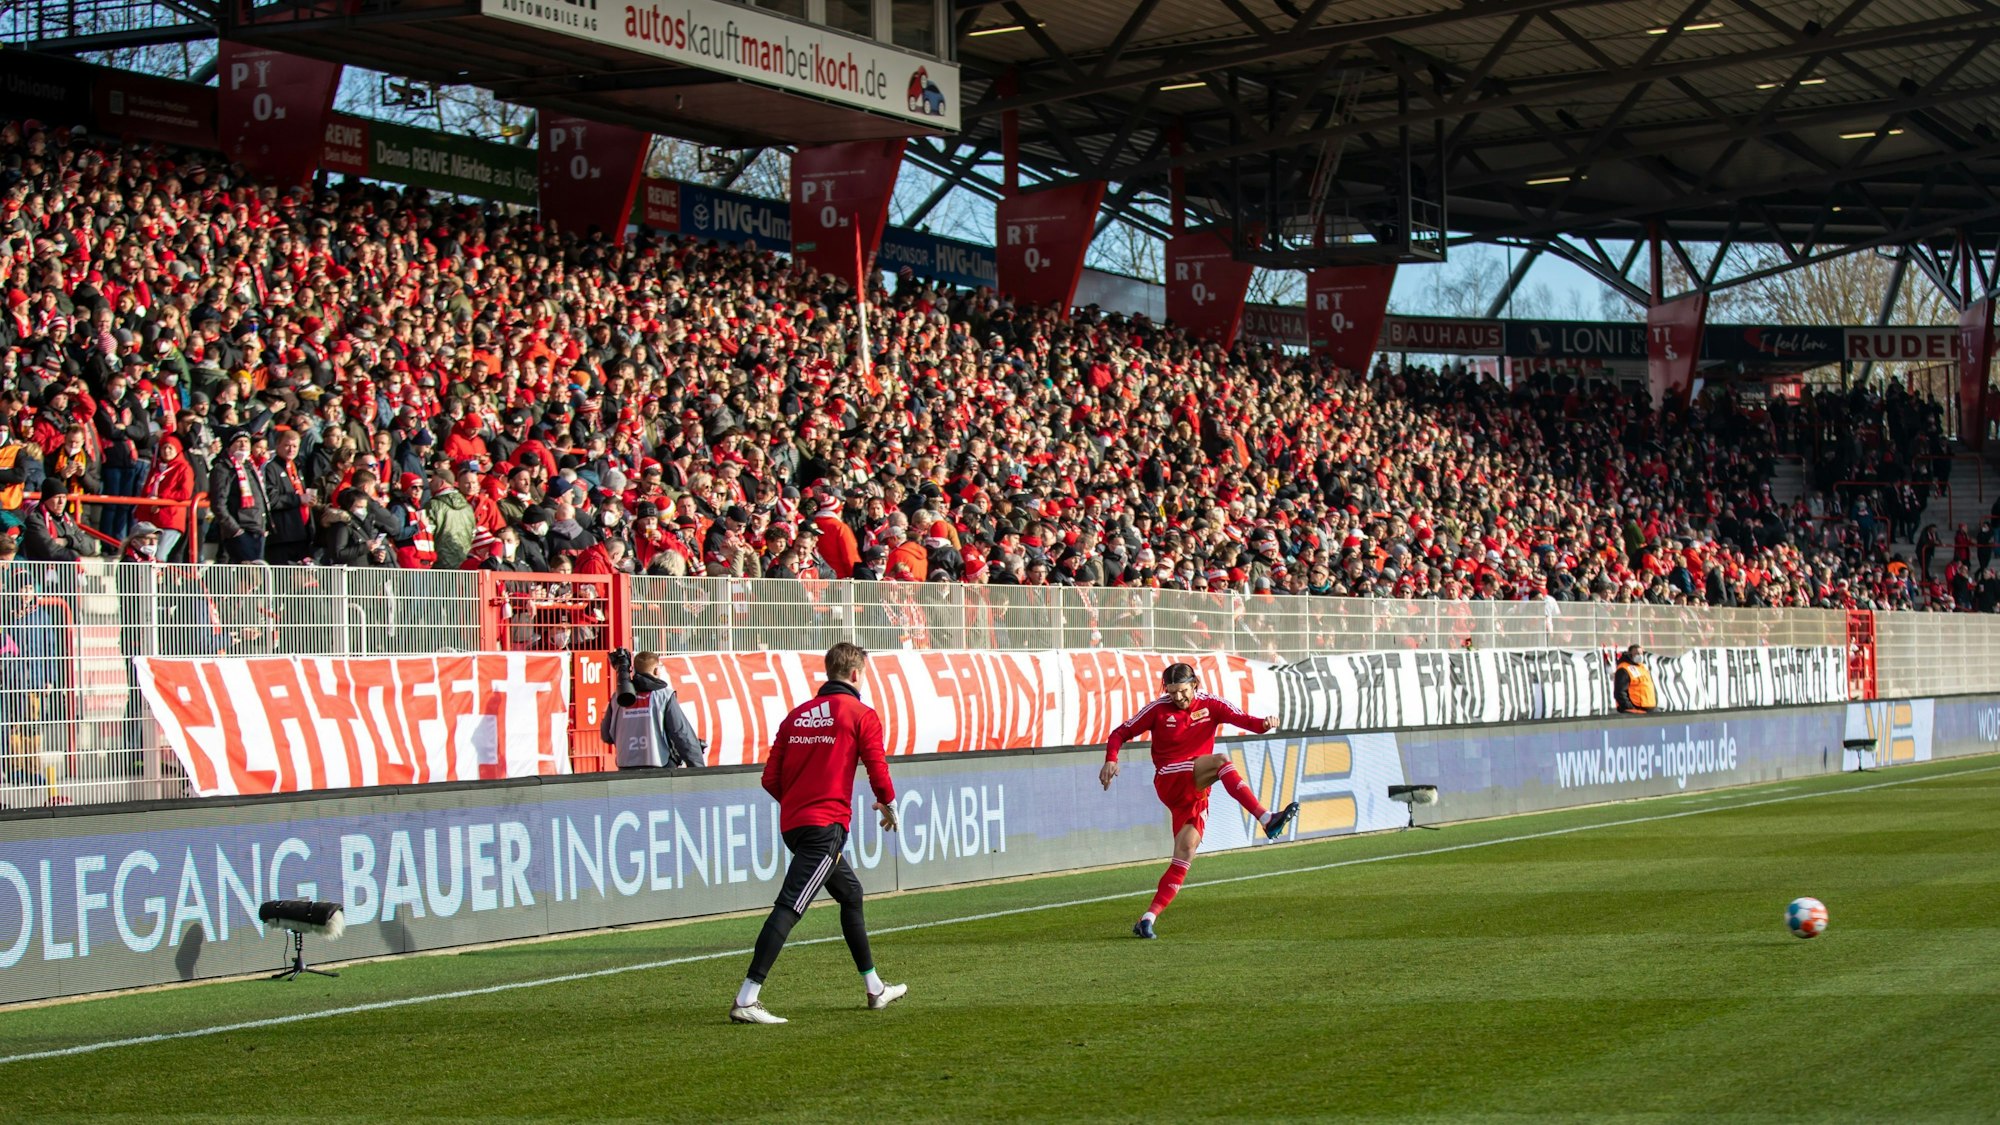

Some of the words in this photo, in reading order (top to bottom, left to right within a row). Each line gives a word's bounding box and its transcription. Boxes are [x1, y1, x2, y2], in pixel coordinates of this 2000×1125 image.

[502, 0, 578, 27] AUTOMOBILE
[584, 16, 598, 31] AG
[625, 4, 887, 100] autoskauftmanbeikoch.de
[231, 63, 249, 91] P
[252, 93, 273, 121] O
[325, 123, 363, 149] REWE
[550, 127, 566, 153] P
[342, 151, 363, 167] Markt
[376, 140, 411, 169] Deine
[412, 147, 449, 176] REWE
[450, 153, 493, 184] Märkte
[494, 168, 512, 187] aus
[570, 155, 589, 180] O
[647, 185, 677, 209] REWE
[802, 181, 817, 204] P
[820, 206, 838, 228] O
[1006, 225, 1021, 246] R
[884, 242, 929, 267] SPONSOR
[935, 243, 996, 279] HVG-Um
[1024, 248, 1040, 273] Q
[1175, 262, 1189, 281] R
[1192, 283, 1207, 306] Q
[1316, 294, 1329, 311] R
[1331, 312, 1346, 333] Q
[1391, 323, 1500, 346] BAUHAUS
[1562, 328, 1623, 354] LONI
[580, 656, 602, 685] Tor
[1348, 652, 1403, 730] HAT
[587, 697, 597, 726] 5
[793, 716, 834, 728] adidas
[629, 735, 648, 751] 29
[788, 735, 836, 745] ROUNTOWN
[1556, 722, 1737, 789] www.bauer-ingbau.de
[340, 821, 536, 926] BAUER
[552, 794, 884, 902] INGENIEUU
[899, 783, 1006, 865] GMBH
